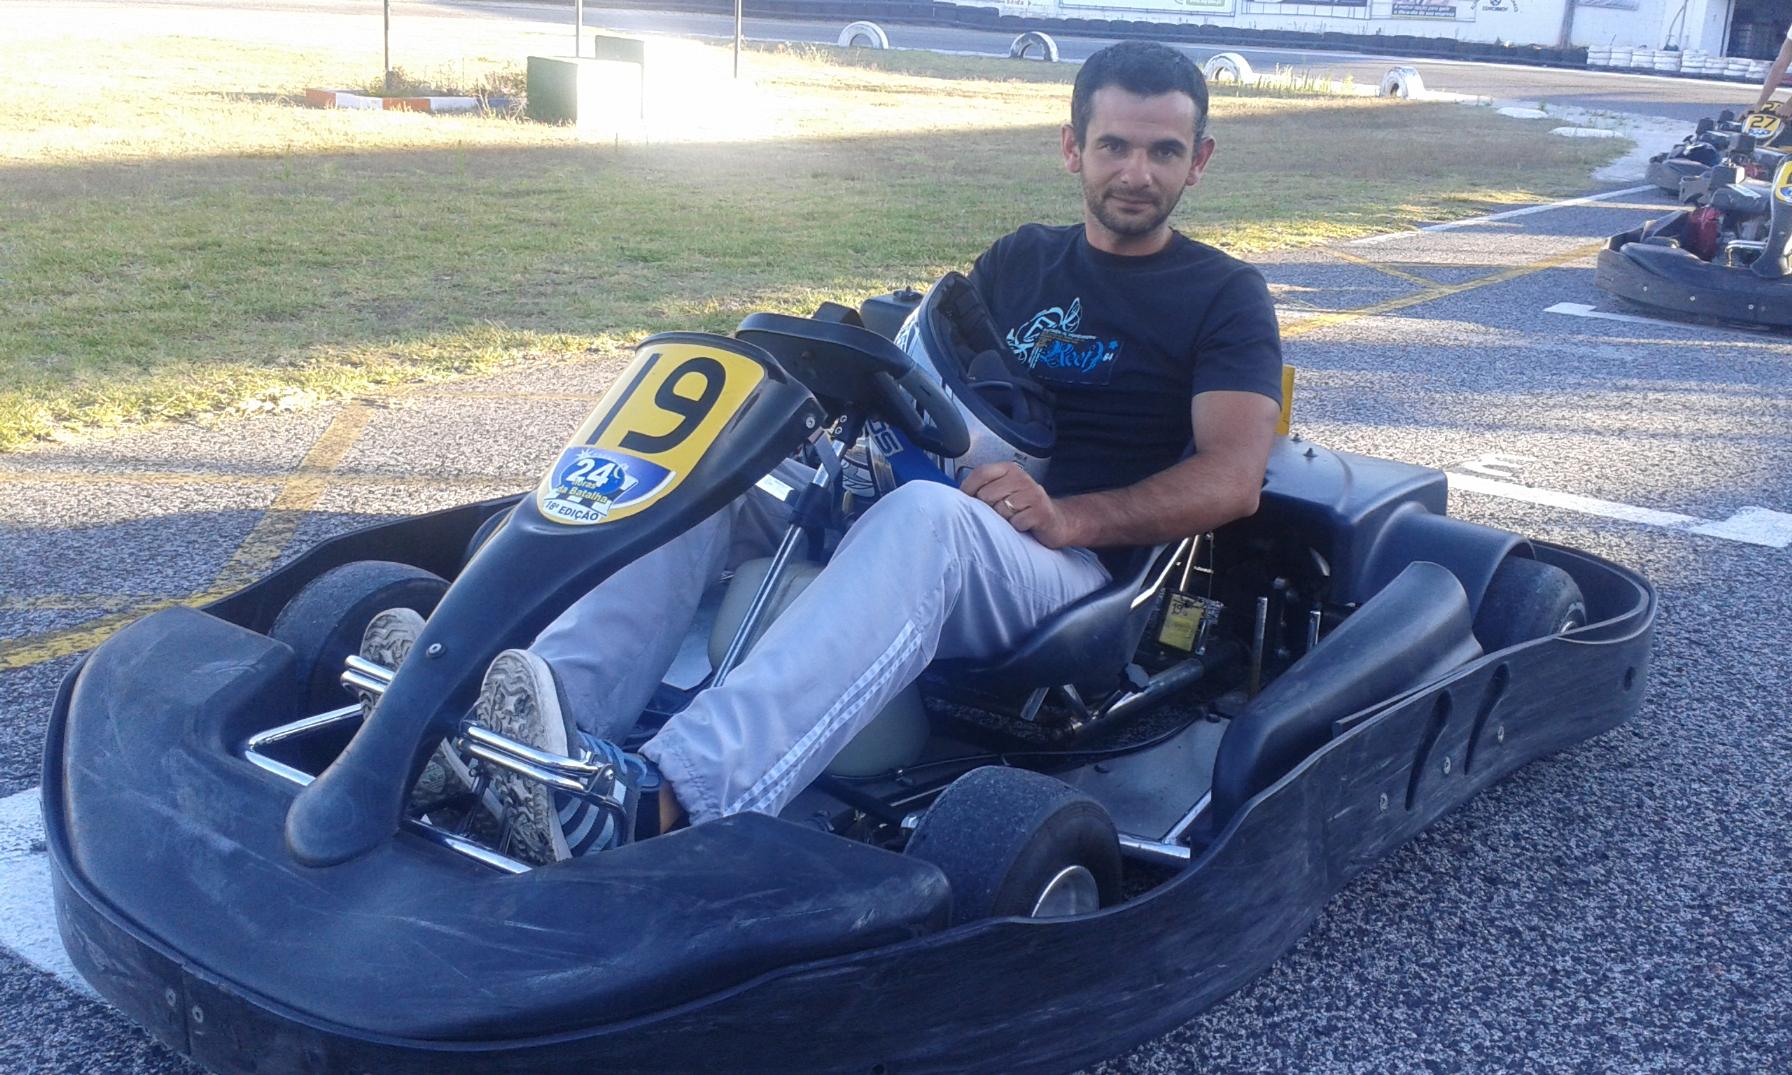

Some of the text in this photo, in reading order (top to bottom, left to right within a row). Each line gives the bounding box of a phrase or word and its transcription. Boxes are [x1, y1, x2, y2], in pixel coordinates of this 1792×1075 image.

[1750, 115, 1777, 128] 27
[585, 353, 727, 454] 19
[565, 458, 616, 487] 24
[570, 486, 609, 504] Batalha
[558, 506, 599, 521] EDIÇÃO
